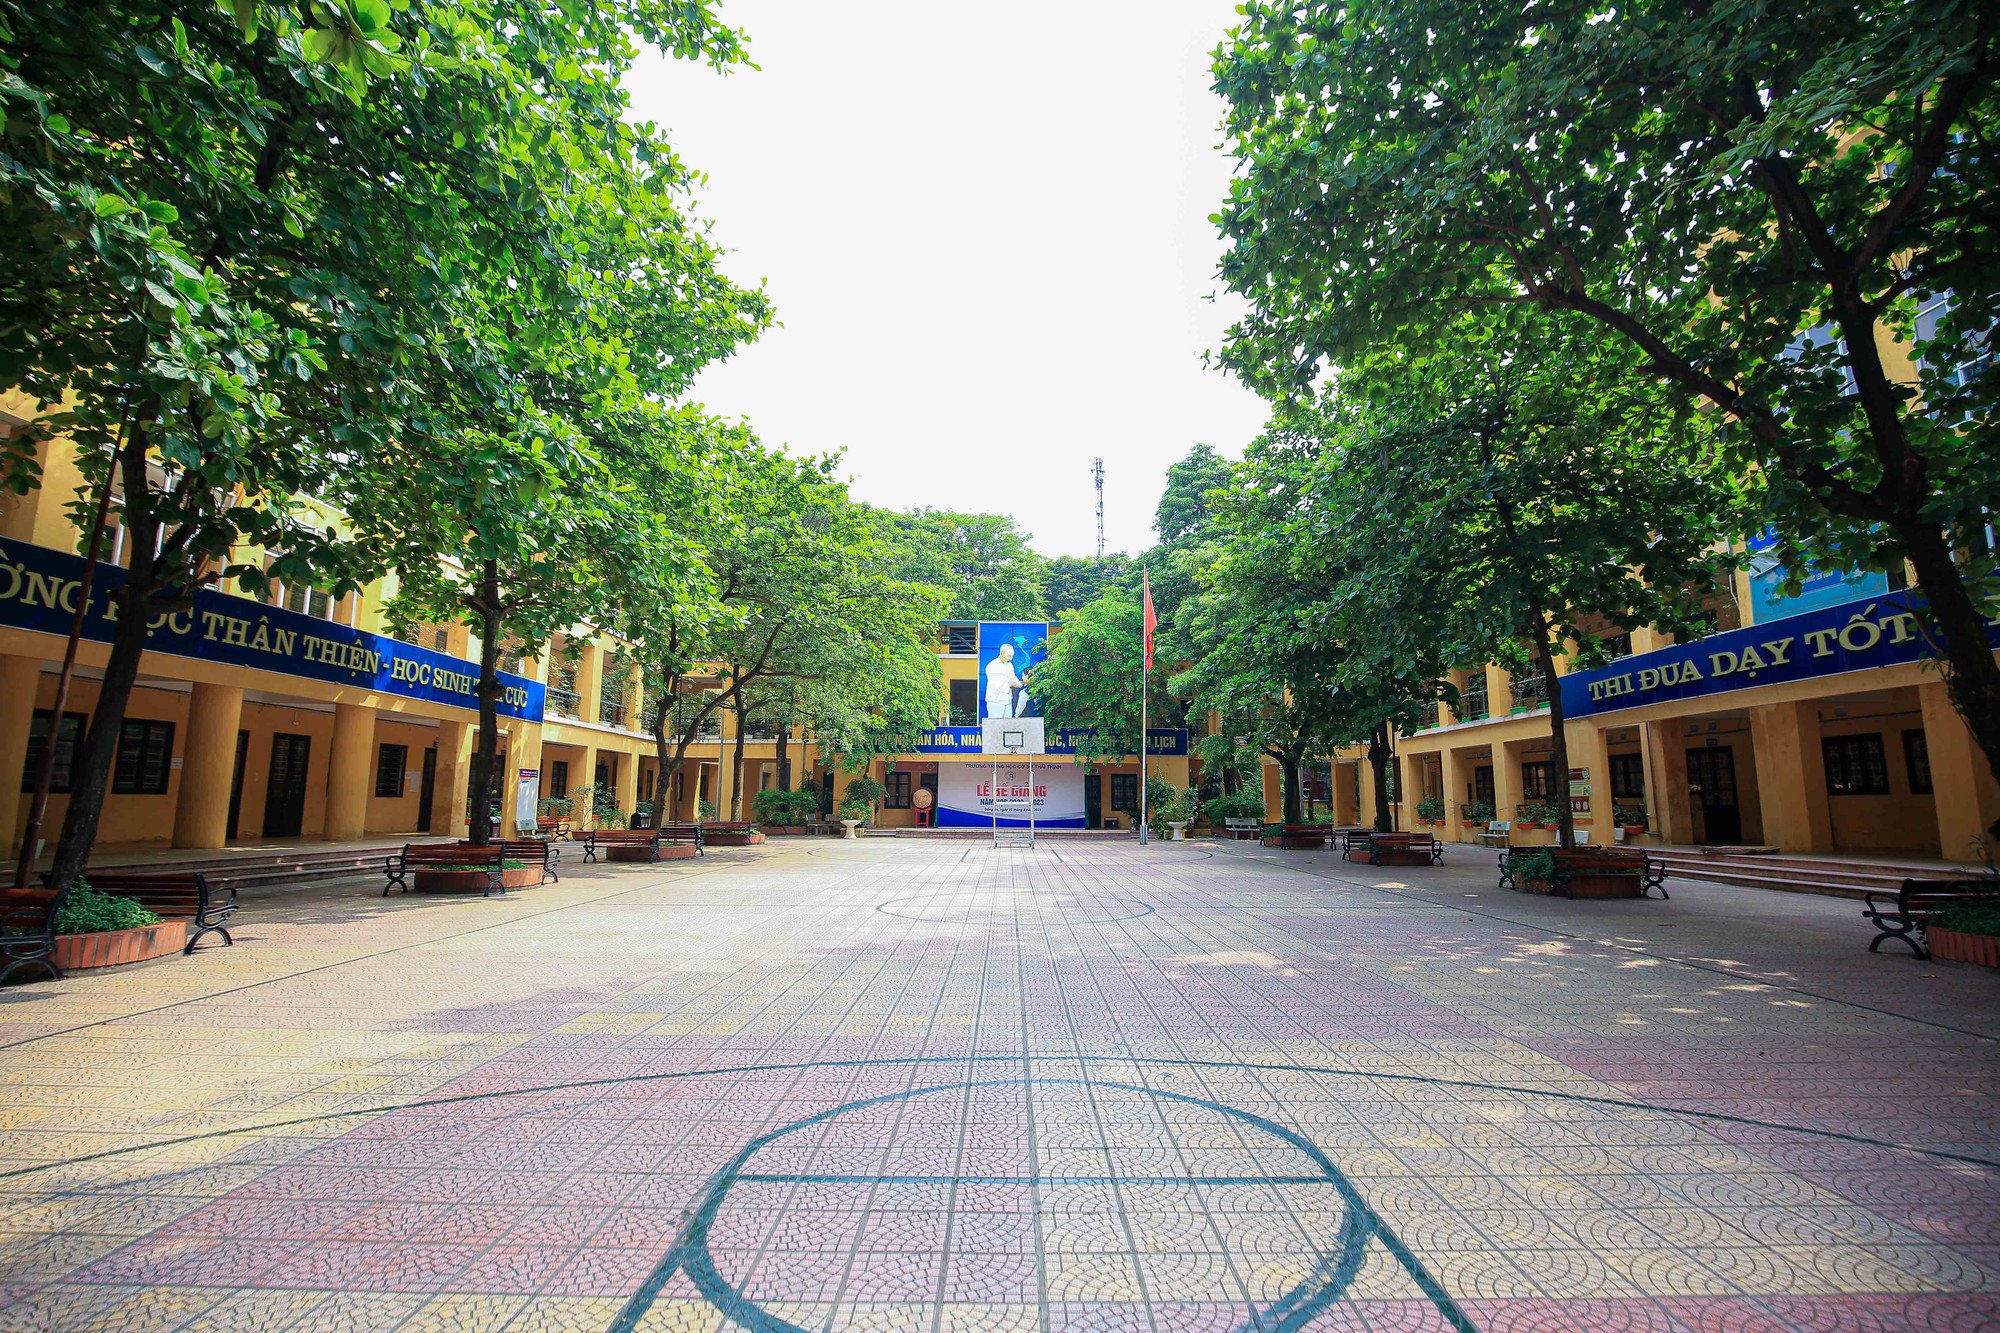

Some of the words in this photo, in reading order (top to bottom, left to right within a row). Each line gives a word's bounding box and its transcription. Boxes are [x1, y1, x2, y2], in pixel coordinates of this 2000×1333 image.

[202, 611, 298, 656] THÂN
[303, 637, 381, 677] THIỆN
[391, 657, 432, 689] HỌC
[433, 667, 471, 694] SINH
[505, 686, 529, 711] CỰC
[1588, 672, 1635, 701] THI
[1637, 659, 1704, 692] ĐUA
[1708, 637, 1795, 678] DẠY
[1804, 603, 1917, 658] TỐT
[934, 731, 958, 748] HÓA,
[961, 731, 982, 746] NHÀ
[1154, 736, 1176, 753] LỊCH
[976, 780, 990, 797] LỄ
